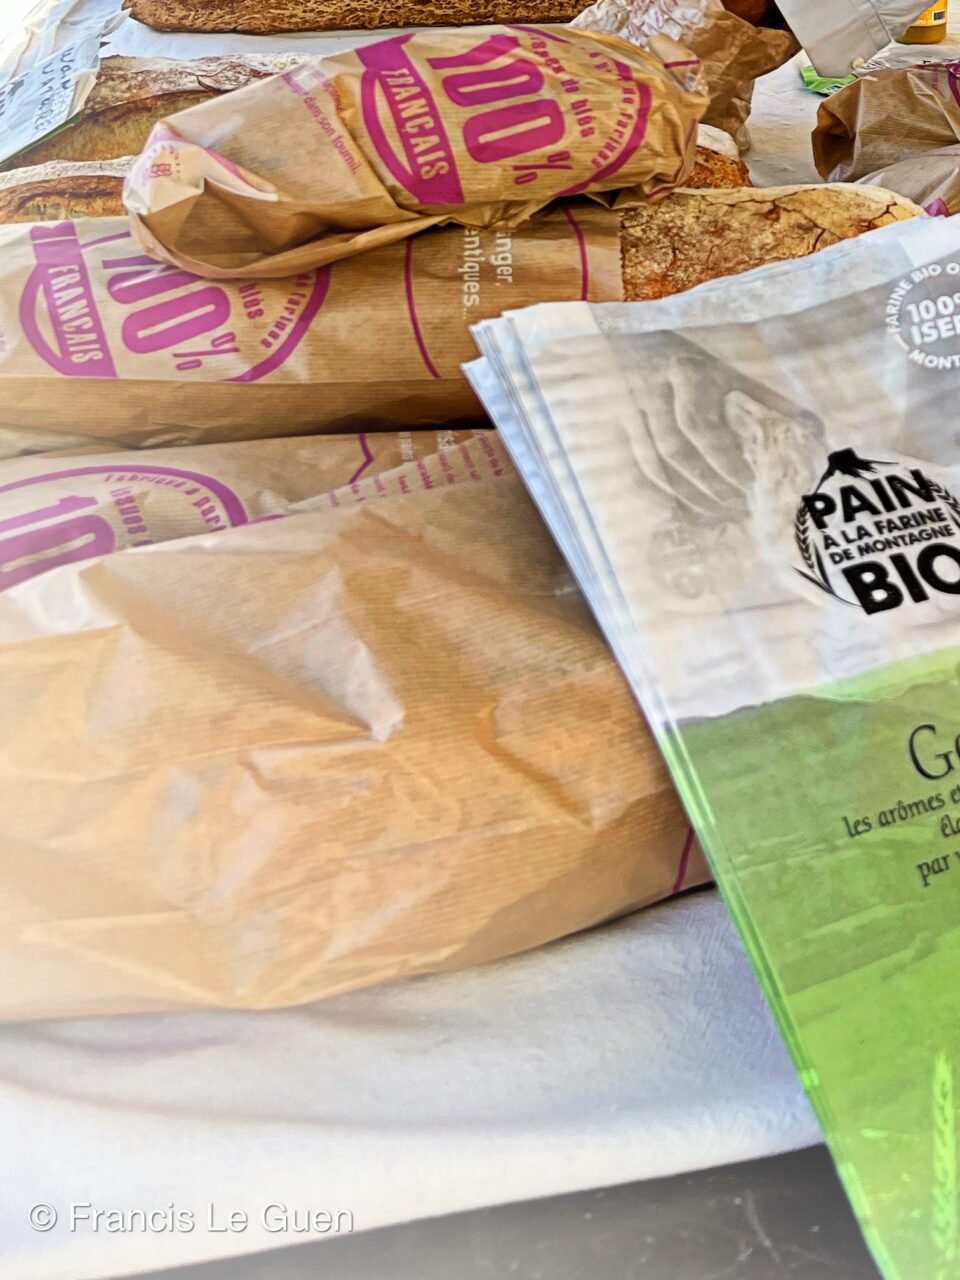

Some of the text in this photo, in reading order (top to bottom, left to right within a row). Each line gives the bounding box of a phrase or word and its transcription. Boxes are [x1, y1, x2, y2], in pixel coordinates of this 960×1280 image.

[381, 68, 450, 181] FRANÇAIS
[426, 33, 573, 186] 100%
[458, 228, 485, 320] entiques...
[885, 279, 913, 334] FARINE
[910, 263, 943, 283] BIO
[801, 469, 937, 531] PAIN
[821, 506, 948, 551] À LA FARINE
[829, 523, 957, 565] DE MONTAGNE
[842, 816, 872, 839] les
[878, 792, 945, 828] arômes
[916, 854, 951, 888] par
